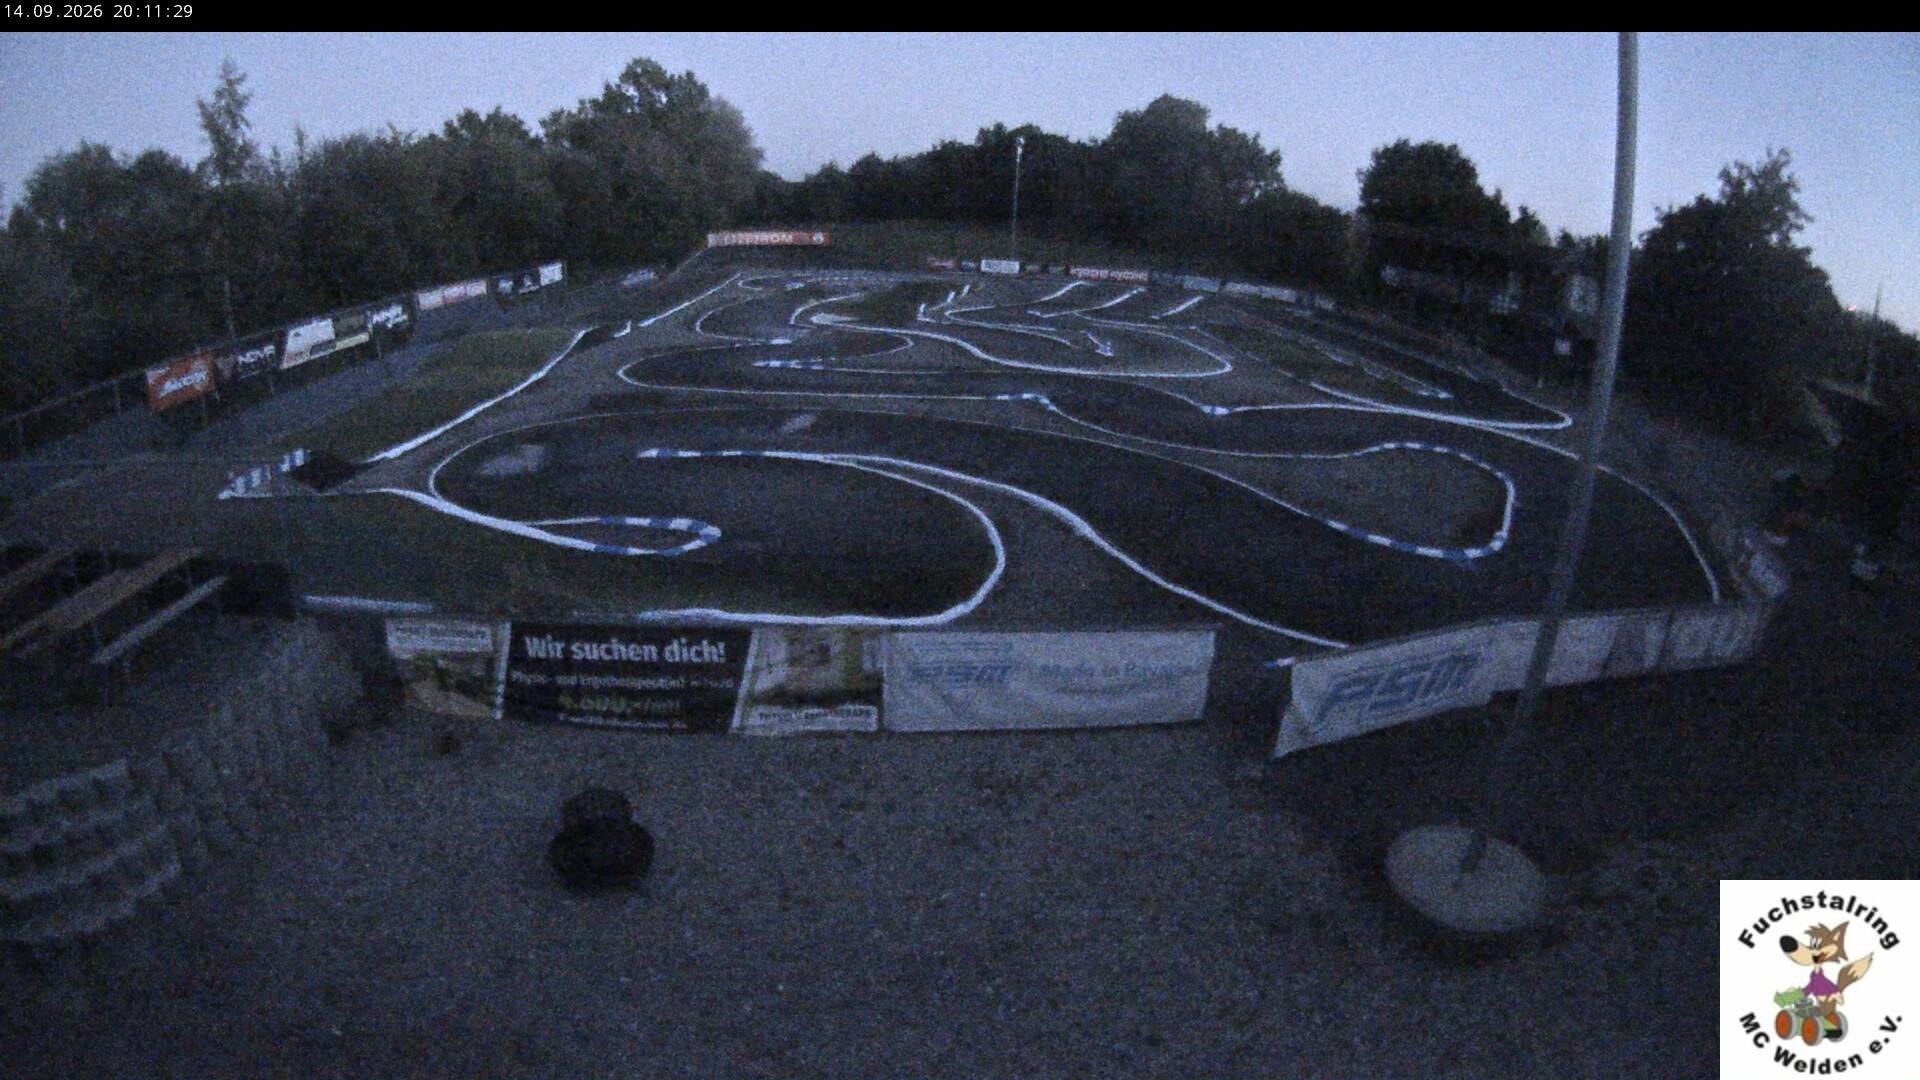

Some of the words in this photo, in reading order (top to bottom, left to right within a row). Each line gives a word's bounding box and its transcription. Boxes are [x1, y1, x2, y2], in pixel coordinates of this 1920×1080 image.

[524, 634, 566, 659] Wir
[570, 638, 660, 662] suchen
[664, 636, 726, 664] dich!
